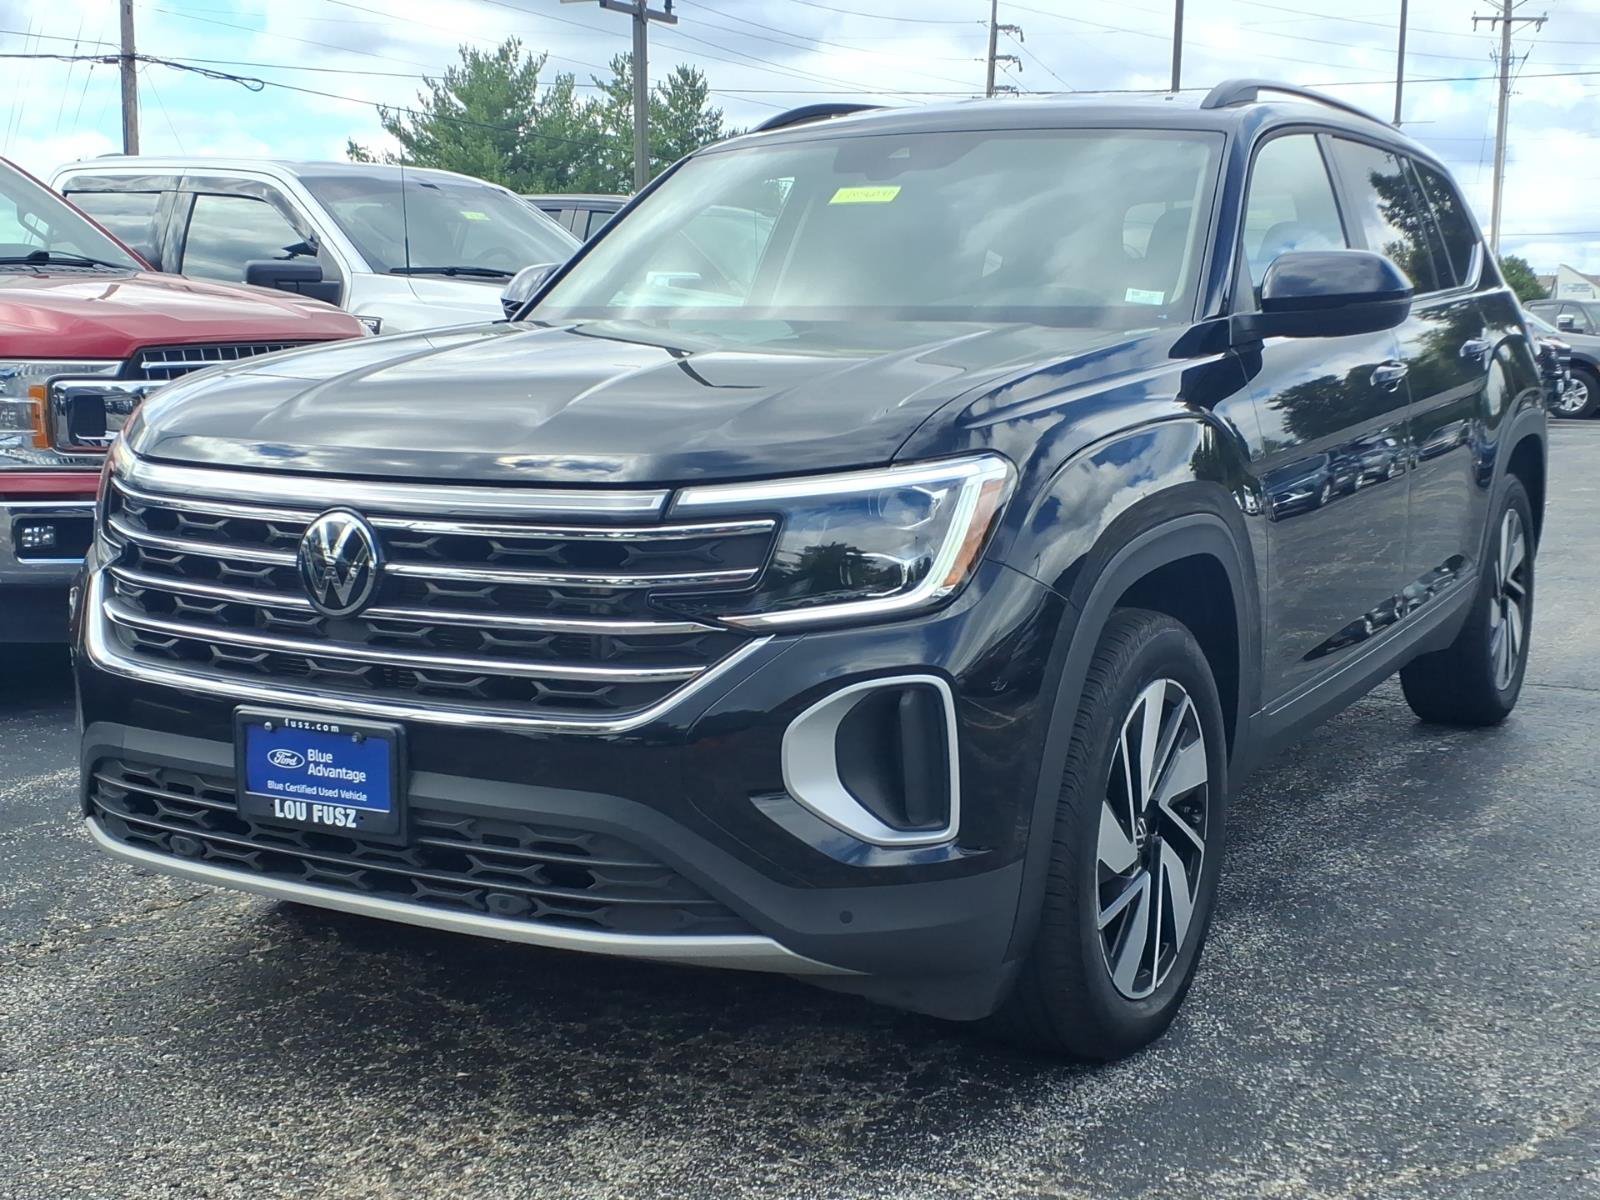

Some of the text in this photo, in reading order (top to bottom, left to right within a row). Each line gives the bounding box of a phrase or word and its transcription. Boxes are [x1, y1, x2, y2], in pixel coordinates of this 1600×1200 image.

[284, 718, 340, 733] fusz.com
[272, 750, 299, 767] Ford
[307, 749, 333, 763] Blue
[307, 764, 366, 783] Advantage
[267, 780, 368, 801] Blue Certified Used Vehicle
[274, 799, 357, 828] LOU FUSZ
